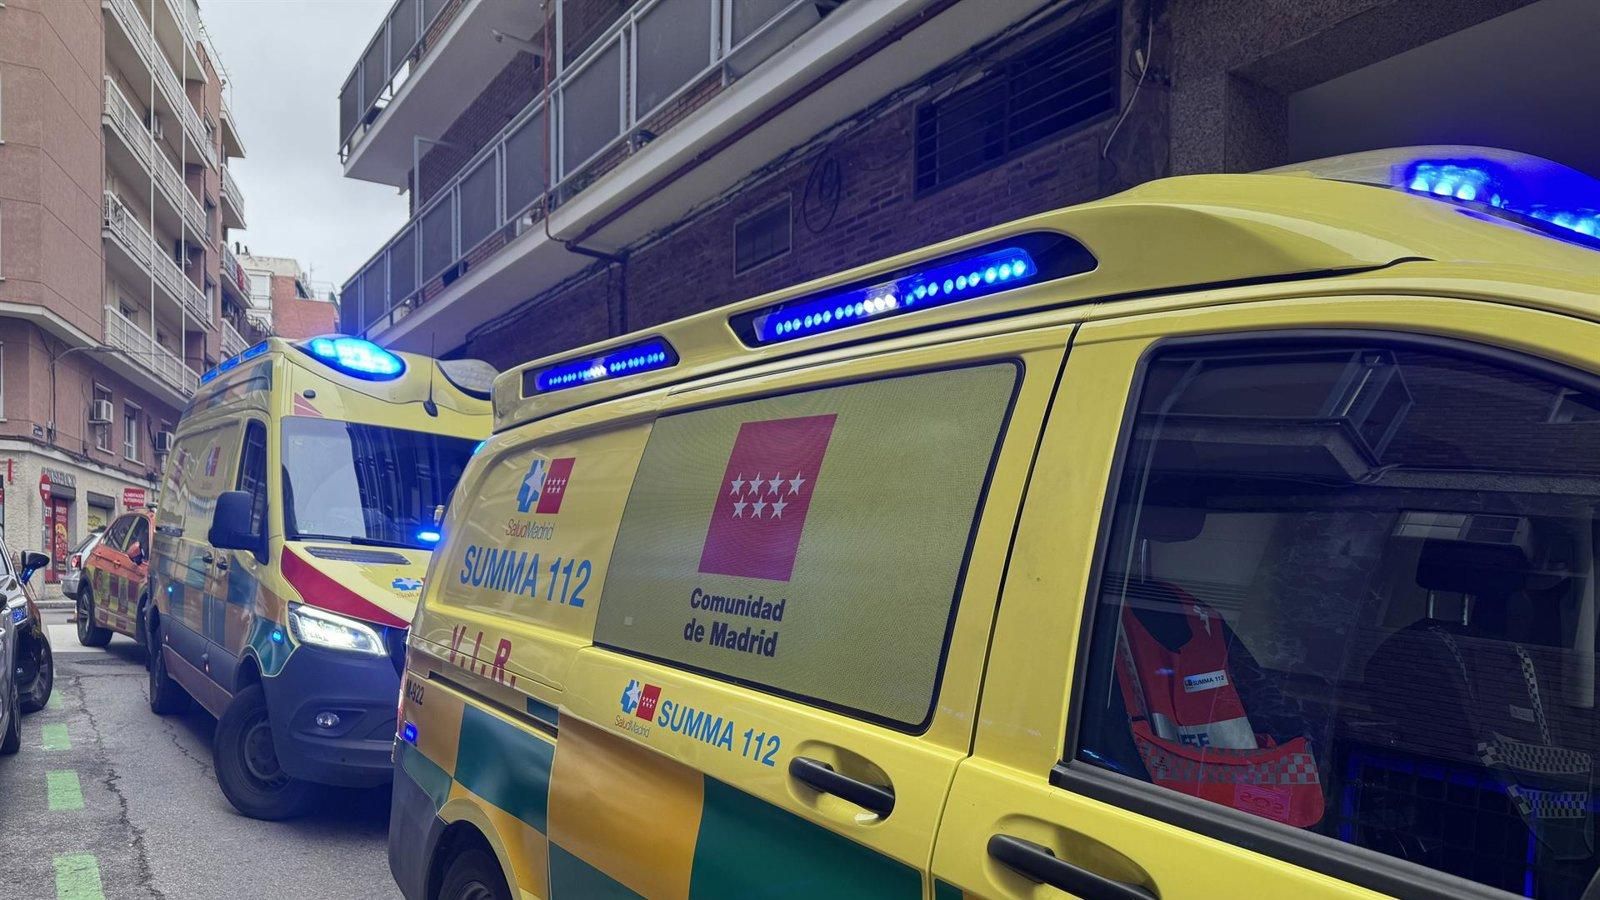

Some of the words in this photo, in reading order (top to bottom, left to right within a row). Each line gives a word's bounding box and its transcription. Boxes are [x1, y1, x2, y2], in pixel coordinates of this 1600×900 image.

[460, 545, 540, 598] SUMMA
[547, 557, 592, 608] 112
[690, 587, 786, 622] Comunidad
[683, 617, 705, 643] de
[708, 621, 779, 657] Madrid
[657, 700, 734, 752] SUMMA
[742, 728, 781, 767] 112
